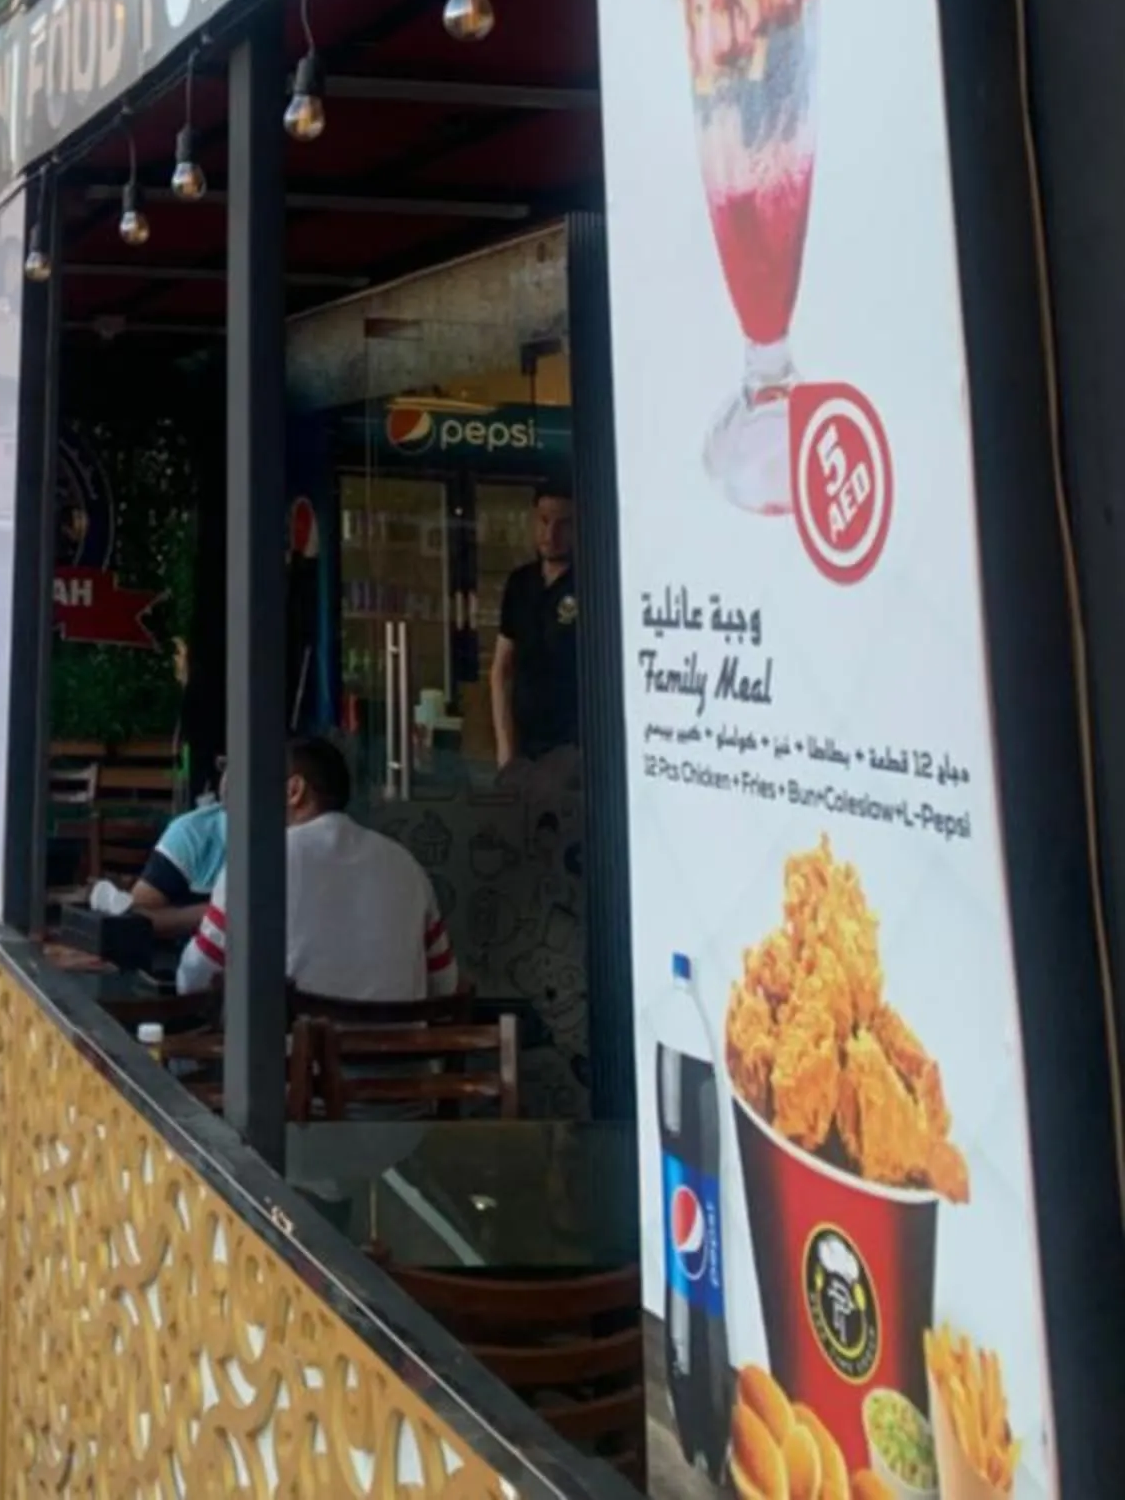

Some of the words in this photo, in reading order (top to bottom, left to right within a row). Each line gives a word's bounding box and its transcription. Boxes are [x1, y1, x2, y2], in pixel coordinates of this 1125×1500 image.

[440, 419, 536, 451] pepsi
[815, 424, 846, 498] 5
[826, 470, 870, 543] AED
[640, 584, 704, 639] عائلية
[709, 593, 763, 647] وجبة
[638, 648, 708, 718] Family
[713, 655, 774, 705] Meal
[681, 760, 732, 791] Chicken
[742, 770, 776, 800] Fries
[912, 750, 934, 779] 12
